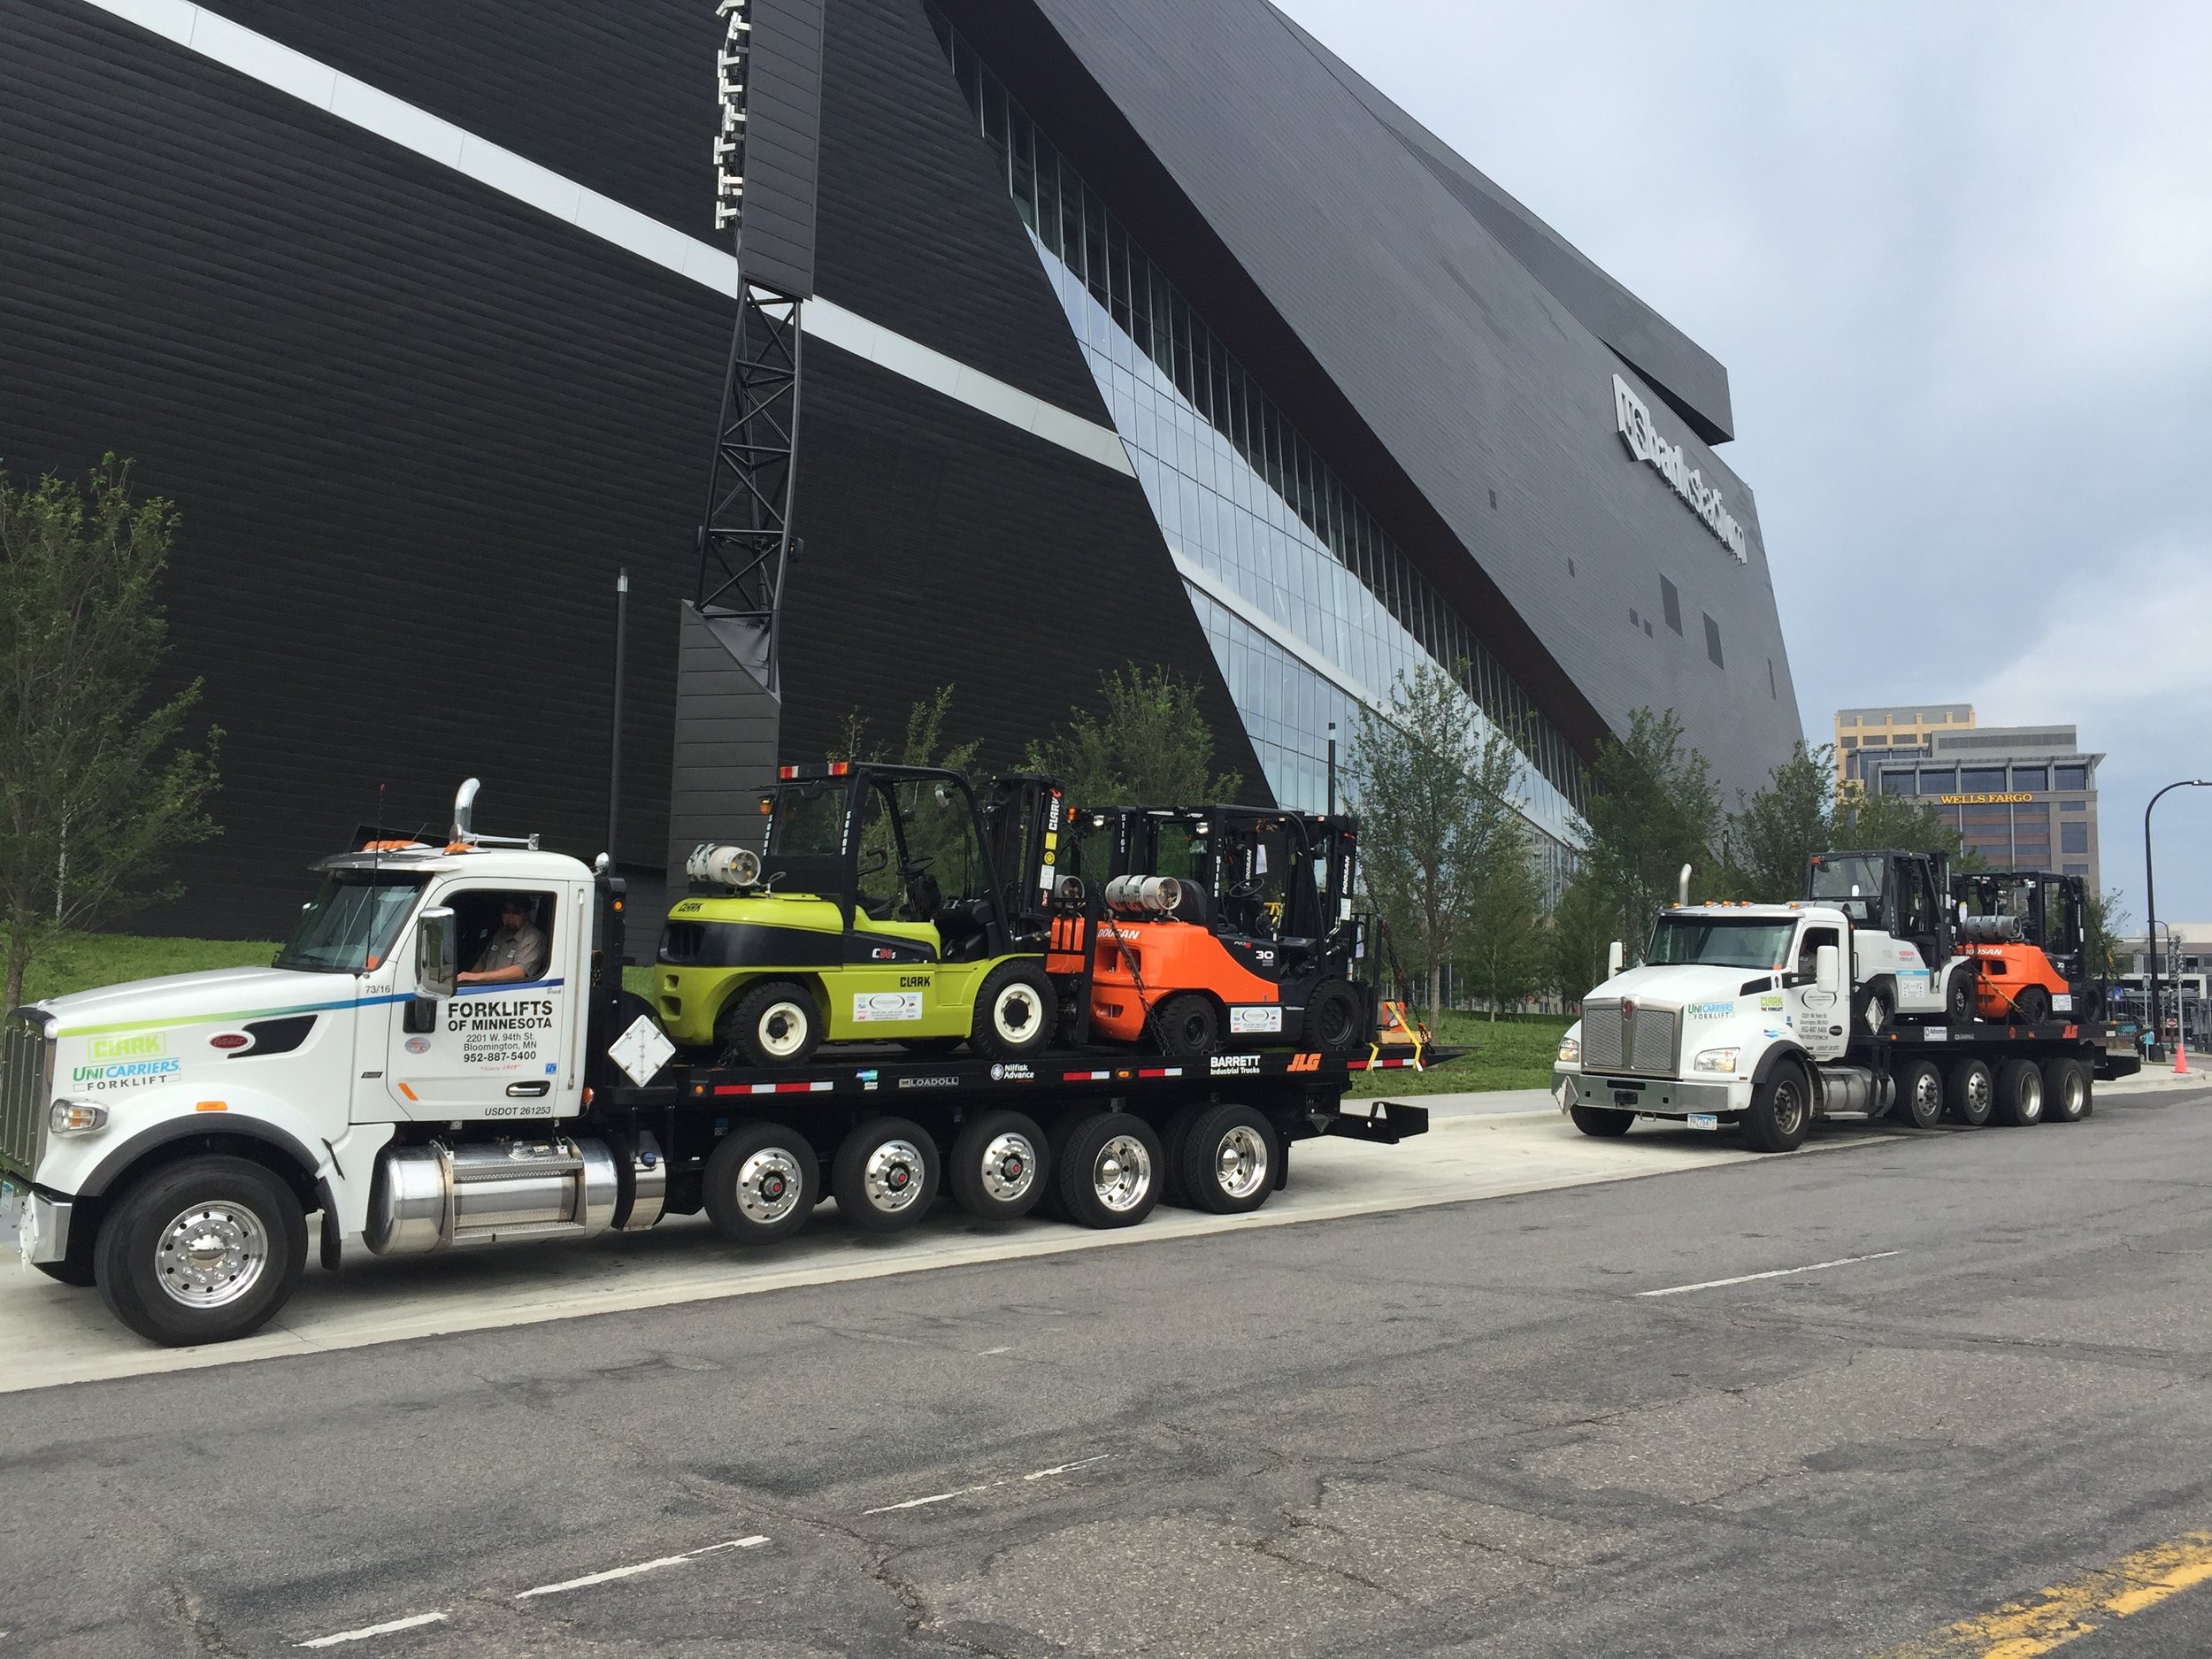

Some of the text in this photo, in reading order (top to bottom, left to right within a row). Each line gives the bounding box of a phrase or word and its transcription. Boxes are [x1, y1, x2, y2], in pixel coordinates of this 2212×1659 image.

[1940, 793, 2032, 804] WELLS FARGO
[677, 902, 705, 913] CLARK
[1256, 950, 1274, 960] 30
[900, 977, 931, 987] CLARK
[365, 985, 391, 994] 73/16
[1760, 996, 1783, 1006] CLARK
[448, 1001, 553, 1018] FORKLIFTS
[448, 1018, 552, 1032] OF MINNESOTA
[2062, 1025, 2078, 1038] JLG
[94, 1035, 160, 1059] CLARK
[464, 1042, 520, 1051] Bloomington,
[464, 1051, 536, 1063] 952-887-5400
[1210, 1055, 1261, 1067] BARRETT
[1286, 1053, 1322, 1071] JLG
[1004, 1064, 1029, 1072] Nilfisk
[1003, 1070, 1035, 1079] Advance
[87, 1075, 167, 1091] FORKLIFT
[485, 1106, 551, 1117] USDOT 261253
